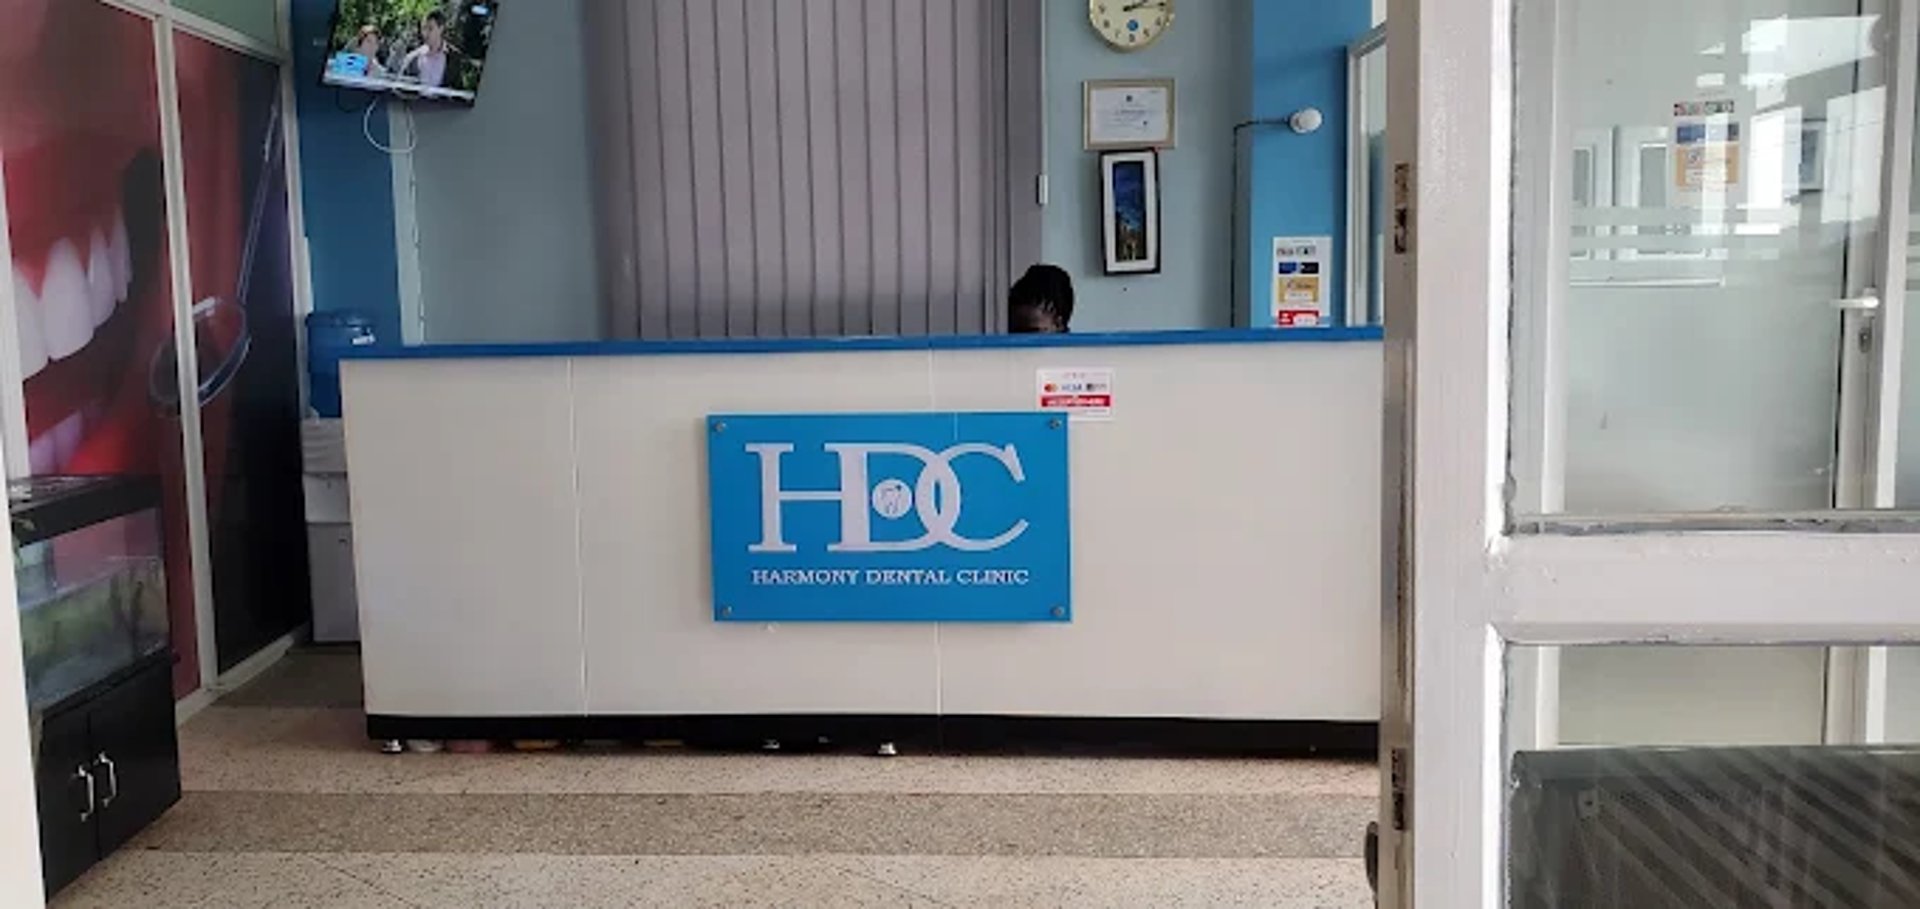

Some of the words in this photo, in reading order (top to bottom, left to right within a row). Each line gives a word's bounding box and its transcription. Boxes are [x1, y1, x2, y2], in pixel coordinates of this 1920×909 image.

[745, 442, 1030, 552] HDC
[752, 569, 858, 585] HARMONY
[865, 569, 950, 585] DENTAL
[957, 569, 1030, 585] CLINIC
